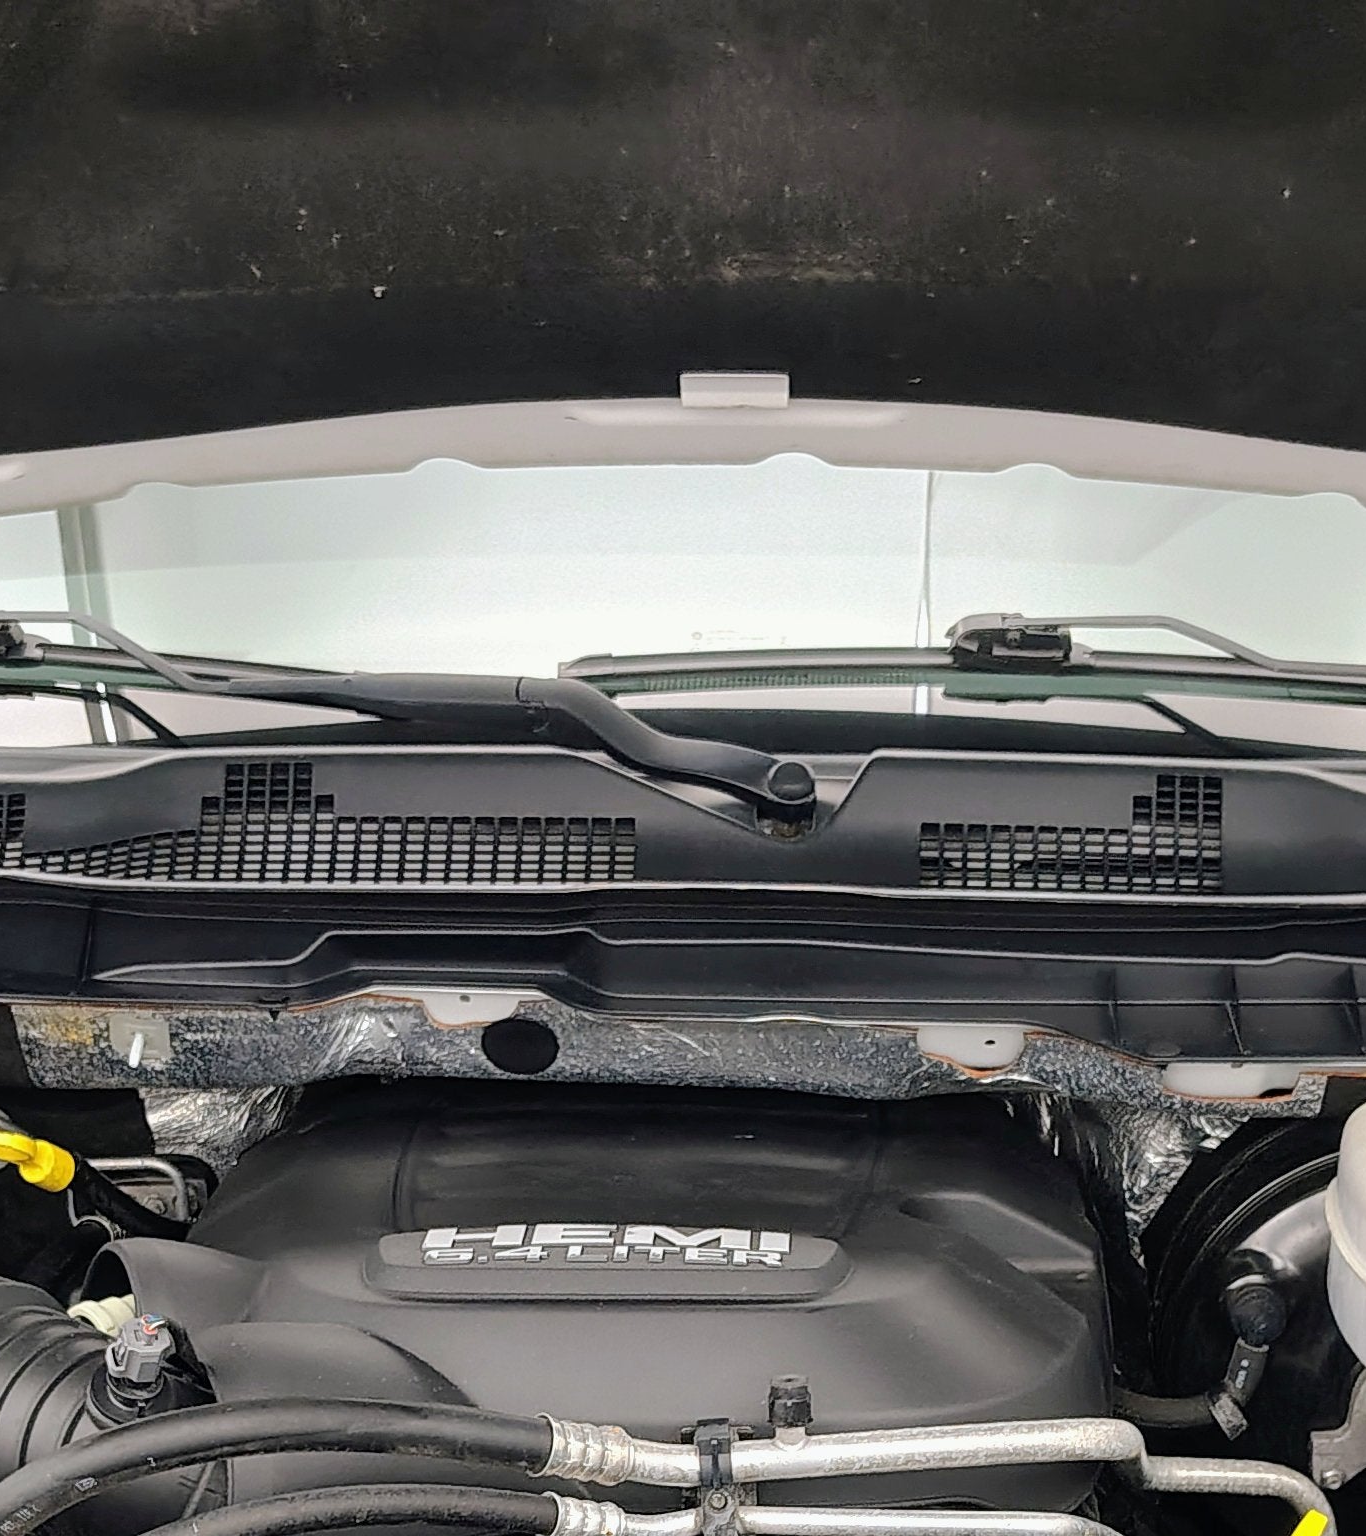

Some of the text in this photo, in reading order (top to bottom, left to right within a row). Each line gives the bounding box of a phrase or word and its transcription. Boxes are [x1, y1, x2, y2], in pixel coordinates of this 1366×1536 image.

[422, 1223, 792, 1255] HEMI
[423, 1245, 785, 1268] 6.4 LITER
